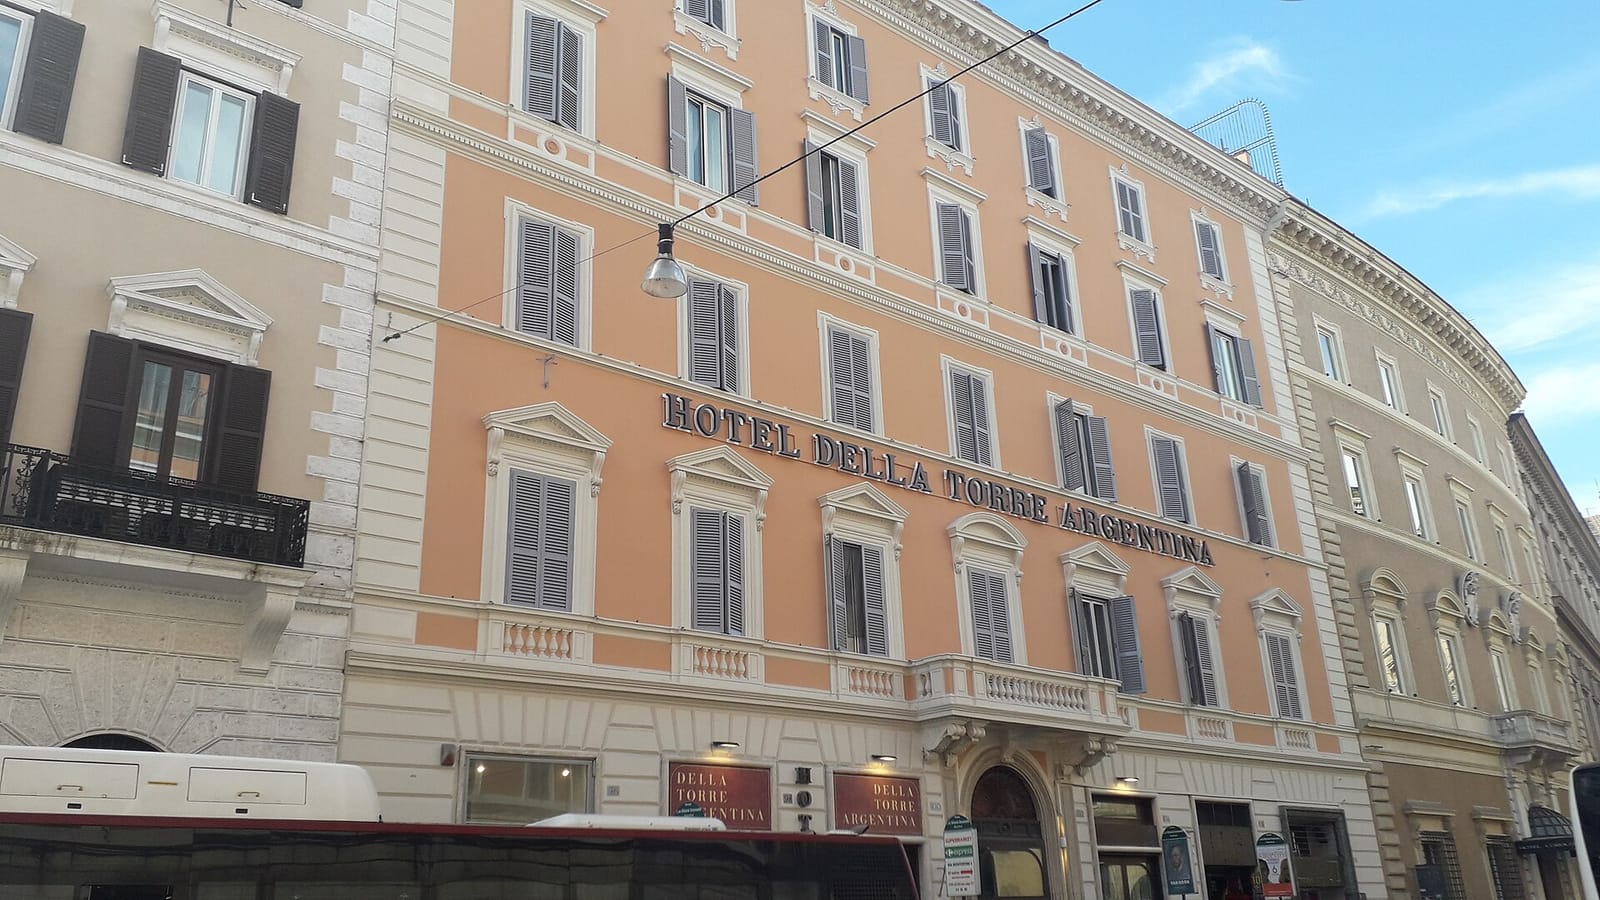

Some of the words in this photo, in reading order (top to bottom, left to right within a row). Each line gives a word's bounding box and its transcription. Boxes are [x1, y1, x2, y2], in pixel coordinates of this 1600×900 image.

[661, 393, 801, 459] HOTEL
[812, 433, 932, 495] DELLA
[943, 469, 1049, 524] TORRE
[1058, 502, 1216, 567] ARGENTINA
[677, 772, 728, 786] DELLA
[676, 788, 728, 803] TORRE
[874, 783, 915, 798] DELLA
[874, 799, 916, 813] TORRE
[703, 806, 765, 823] ENTINA
[843, 813, 917, 828] ARGENTINA
